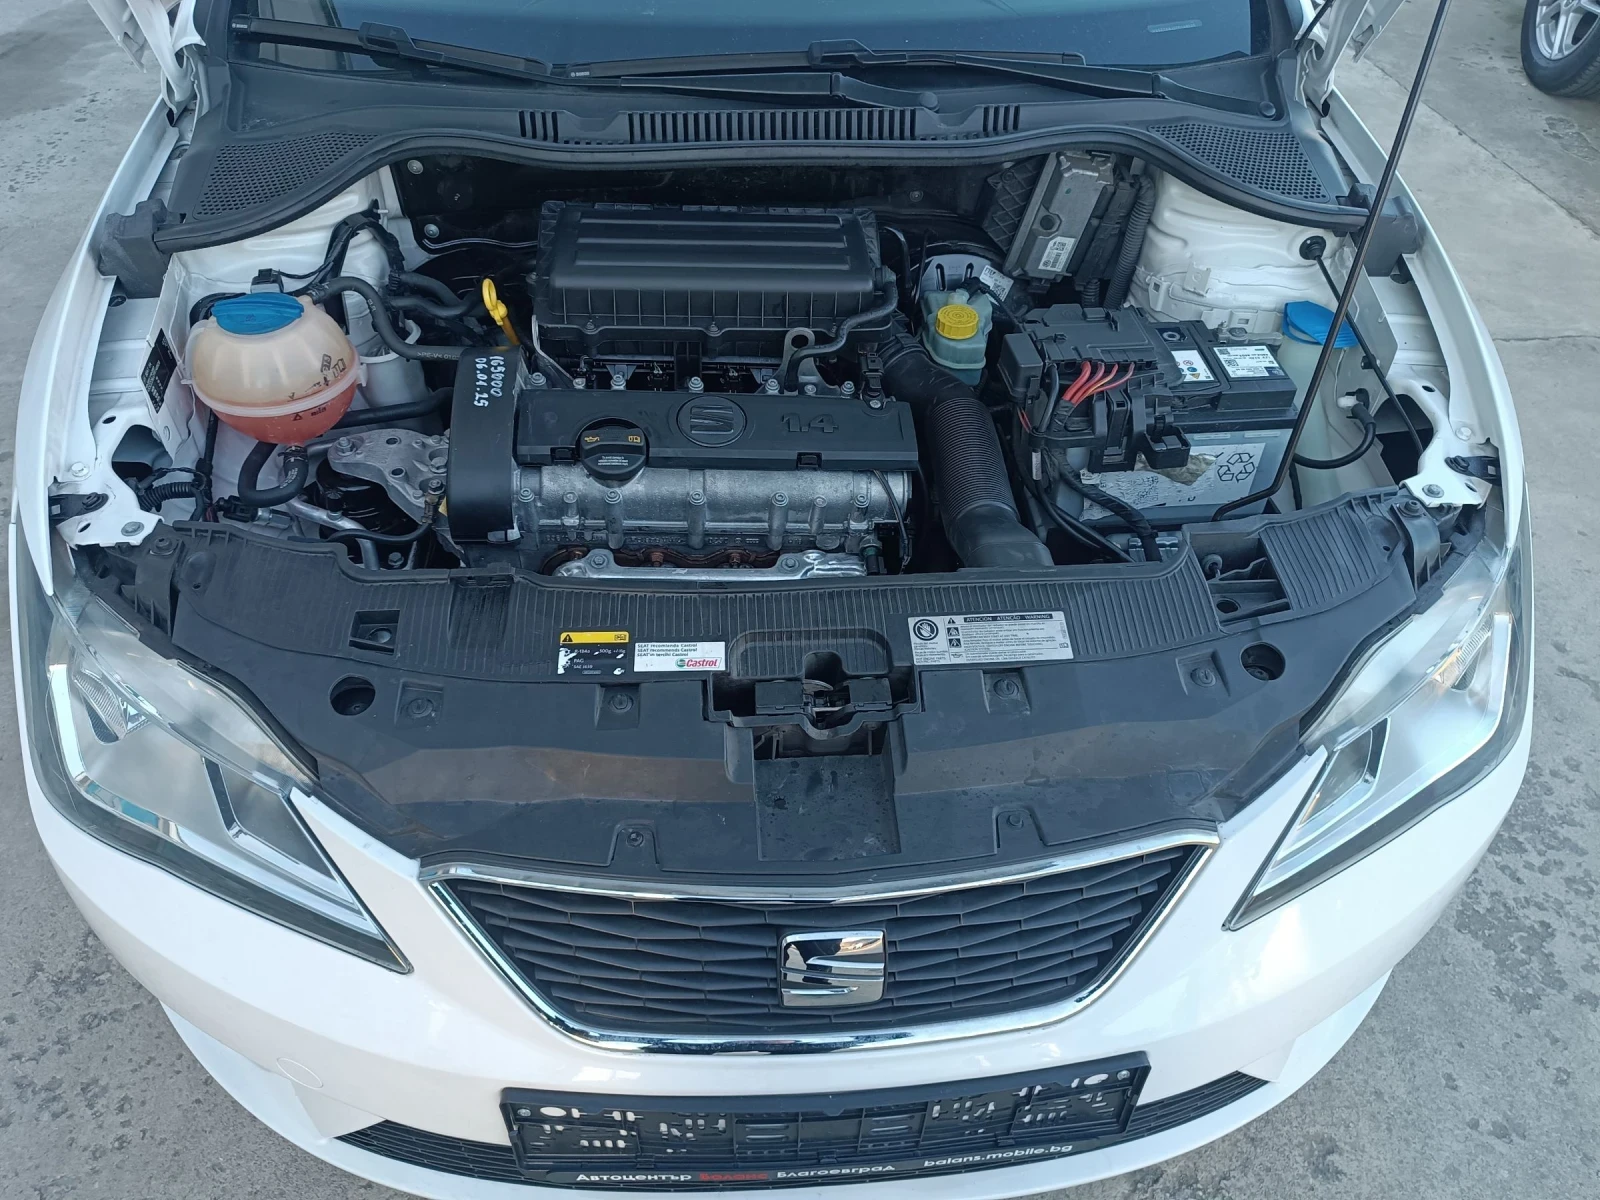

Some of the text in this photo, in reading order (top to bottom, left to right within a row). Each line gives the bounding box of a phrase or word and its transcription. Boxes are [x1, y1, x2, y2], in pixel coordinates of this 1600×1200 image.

[489, 355, 506, 397] 165000
[781, 413, 839, 433] 1.4
[686, 659, 718, 667] Castrol
[923, 1144, 1074, 1167] balans.mobile.bg
[576, 1164, 896, 1182] Автоцентър Баланс Благоевград
